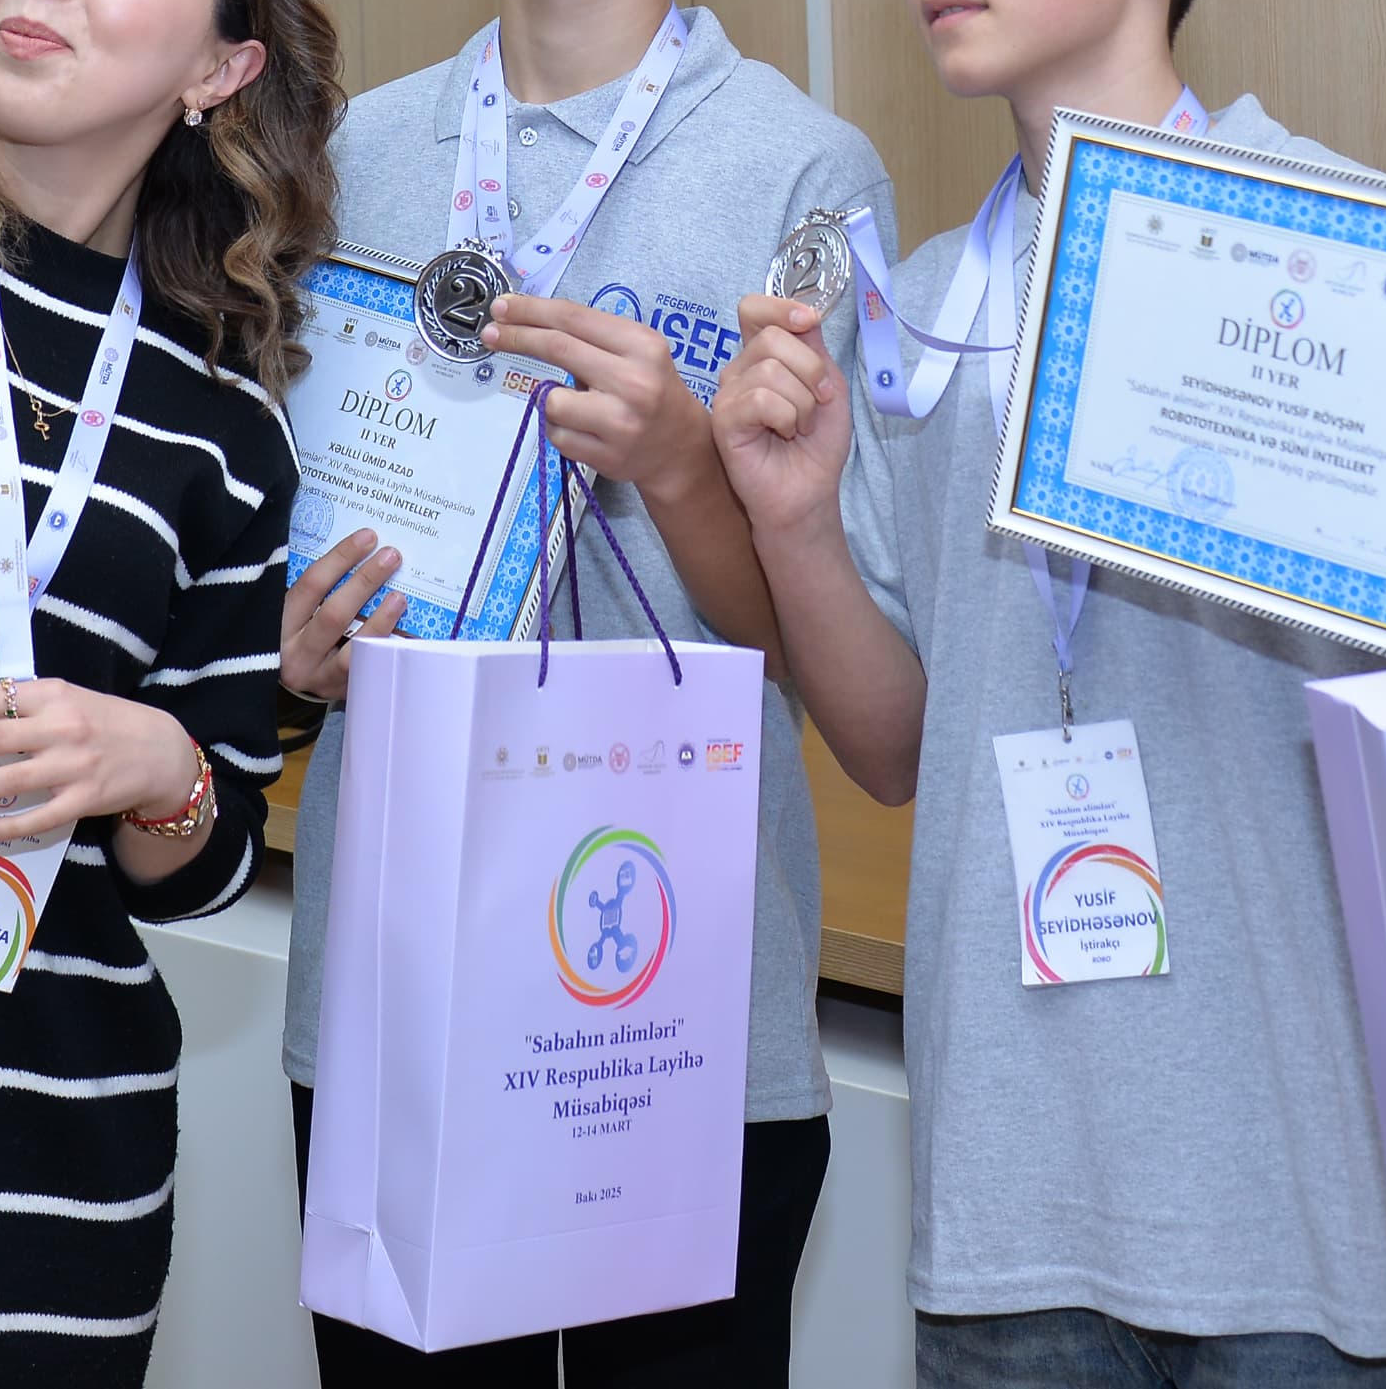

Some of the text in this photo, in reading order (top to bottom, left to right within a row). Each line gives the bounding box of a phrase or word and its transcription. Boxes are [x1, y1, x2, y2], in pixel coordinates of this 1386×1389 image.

[792, 246, 826, 298] 2
[440, 274, 488, 333] 2
[656, 293, 718, 319] REGENERON
[650, 308, 741, 372] ISEF
[1218, 316, 1346, 375] DİPLOM
[1252, 365, 1299, 390] II YER
[338, 389, 439, 440] DİPLOM
[360, 428, 397, 450] II YER
[1260, 435, 1277, 449] VƏ
[328, 441, 414, 478] XƏLİLLİ ÜMİD AZAD
[301, 465, 441, 521] OTOTEXNİKA VƏ SÜNİ İNTELLEKT
[342, 464, 385, 485] Respublika
[386, 477, 413, 495] Layihə
[414, 488, 476, 517] Müsabiqəsində
[347, 499, 364, 512] yerə
[365, 503, 385, 522] layiq
[386, 512, 440, 539] görülmüşdür.
[706, 743, 743, 763] ISEF
[1074, 888, 1116, 908] YUSİF
[1039, 911, 1158, 936] SEYİDHƏSƏNOV
[1080, 938, 1120, 954] İştirakçı
[525, 1018, 684, 1054] "Sabahın alimləri"
[504, 1050, 703, 1091] XIV Respublika Layihə
[553, 1089, 651, 1119] Müsabiqəsi
[572, 1119, 632, 1138] 12-14 MART
[575, 1187, 622, 1204] Bakı 2025
